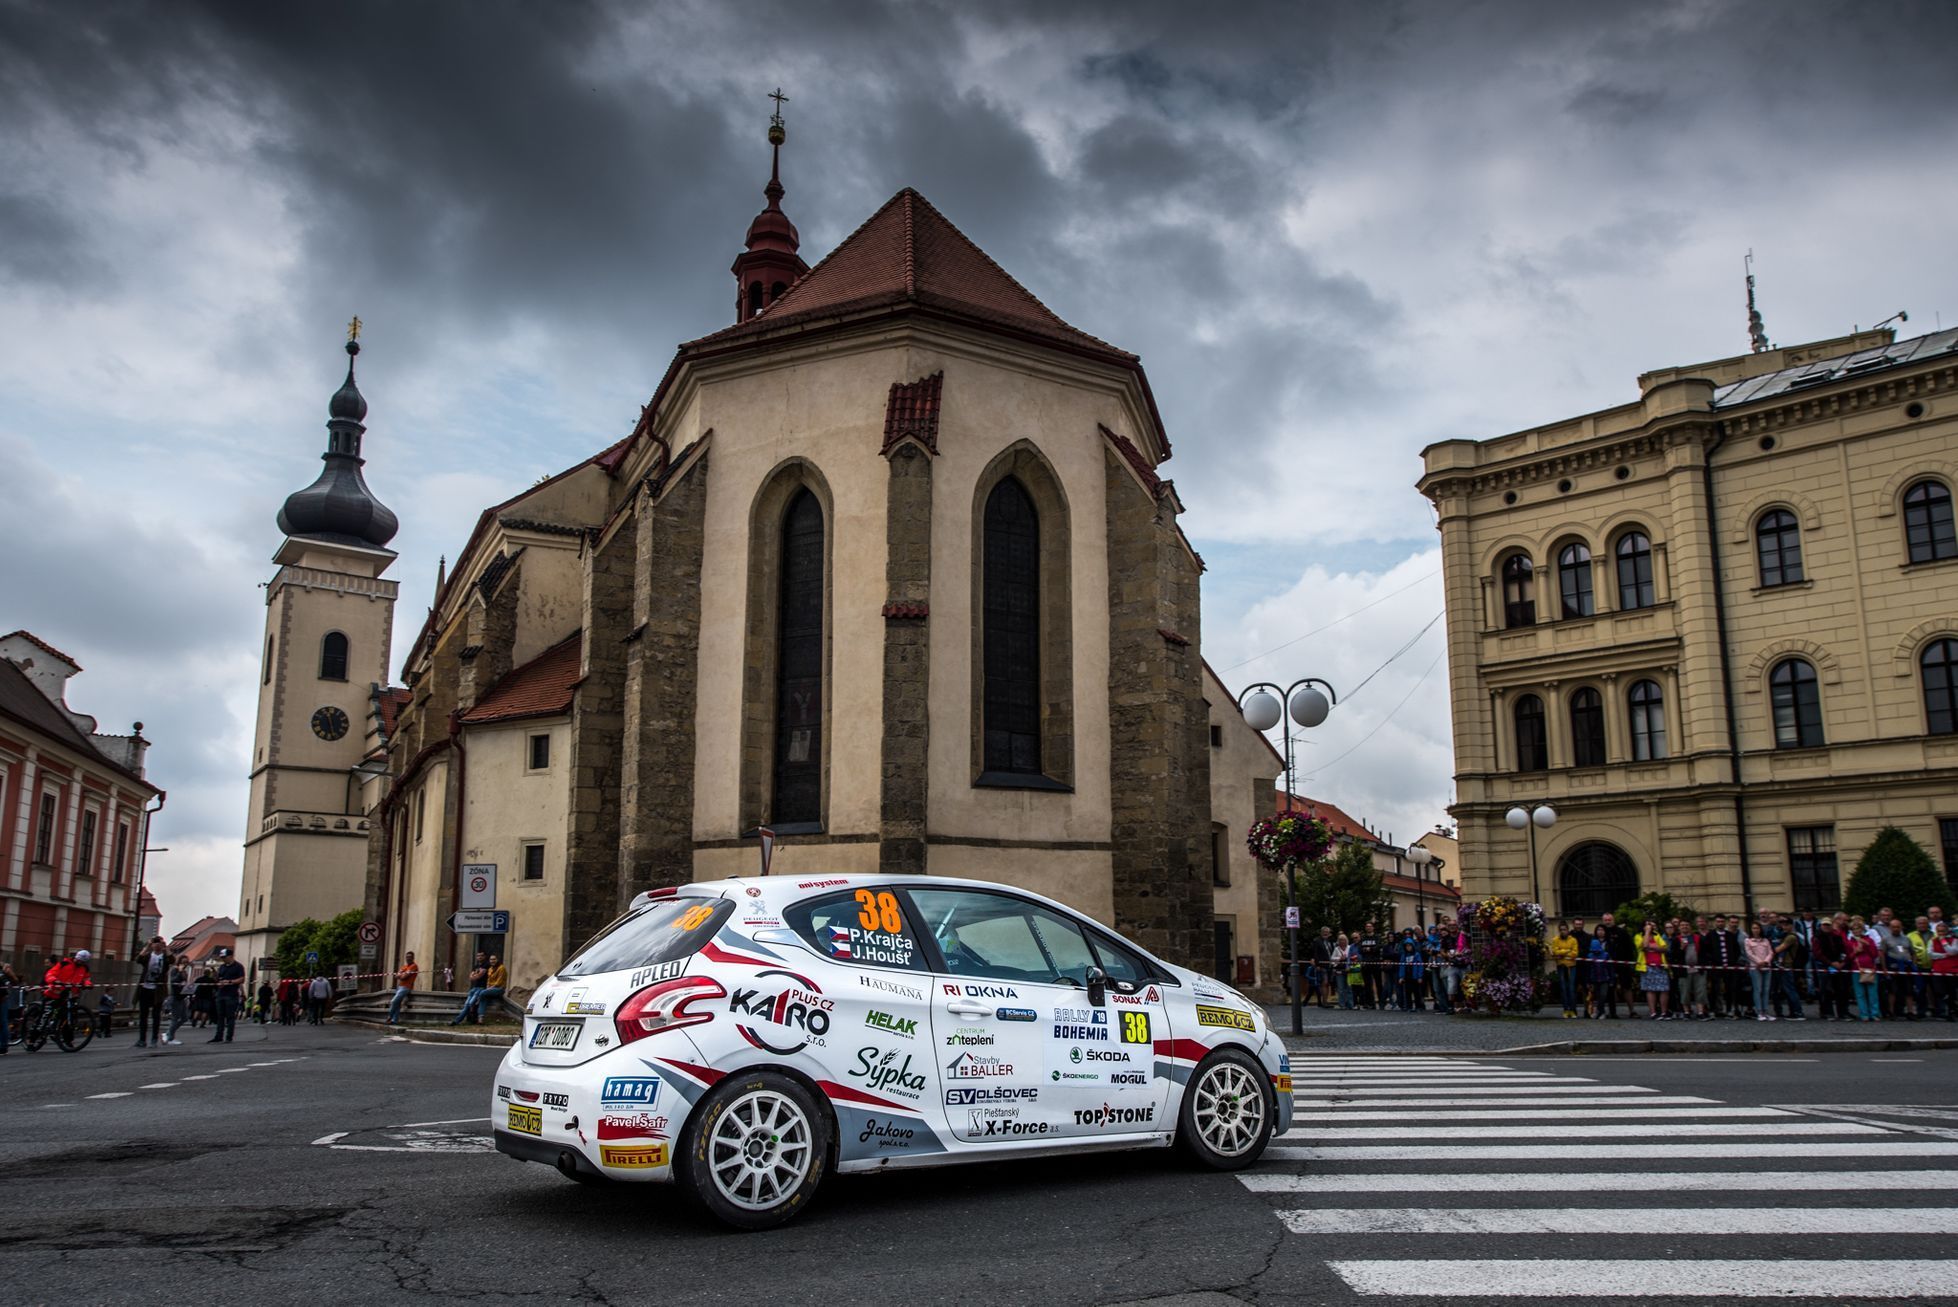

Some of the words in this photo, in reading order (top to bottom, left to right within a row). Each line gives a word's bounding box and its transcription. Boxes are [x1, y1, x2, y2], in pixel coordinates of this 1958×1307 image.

[473, 880, 485, 889] 30
[671, 904, 715, 931] 38
[854, 888, 902, 934] 38
[849, 928, 914, 950] P.Krajča
[852, 944, 911, 965] J.Houšť
[630, 960, 681, 989] APLED
[859, 975, 923, 1001] HAUMANA
[943, 984, 961, 996] RI
[965, 985, 1019, 999] OKNA
[792, 989, 819, 1006] PLUS
[820, 999, 835, 1011] CZ
[1112, 994, 1142, 1005] SONAX
[865, 1009, 918, 1035] HELAK
[1054, 1008, 1090, 1022] RALLY
[1199, 1012, 1232, 1025] REMO
[1054, 1024, 1108, 1041] BOHEMIA
[1124, 1012, 1148, 1044] 38
[806, 1034, 827, 1048] s.r.o.
[974, 1056, 1000, 1066] Stavby
[1086, 1048, 1131, 1062] ŠKODA
[971, 1064, 1014, 1077] BALLER
[1062, 1072, 1099, 1080] ŠKOENERGO
[1110, 1073, 1147, 1085] MOGUL
[544, 1093, 568, 1106] FRYPO
[605, 1083, 654, 1103] hamag
[886, 1086, 920, 1100] restaurace
[947, 1090, 975, 1104] SV
[976, 1086, 1038, 1099] OLŠOVEC
[606, 1114, 636, 1127] Pavel
[639, 1113, 668, 1128] Šafr
[984, 1119, 1048, 1136] X-Force
[859, 1118, 914, 1143] Jakovo
[605, 1148, 662, 1164] PIRELLI
